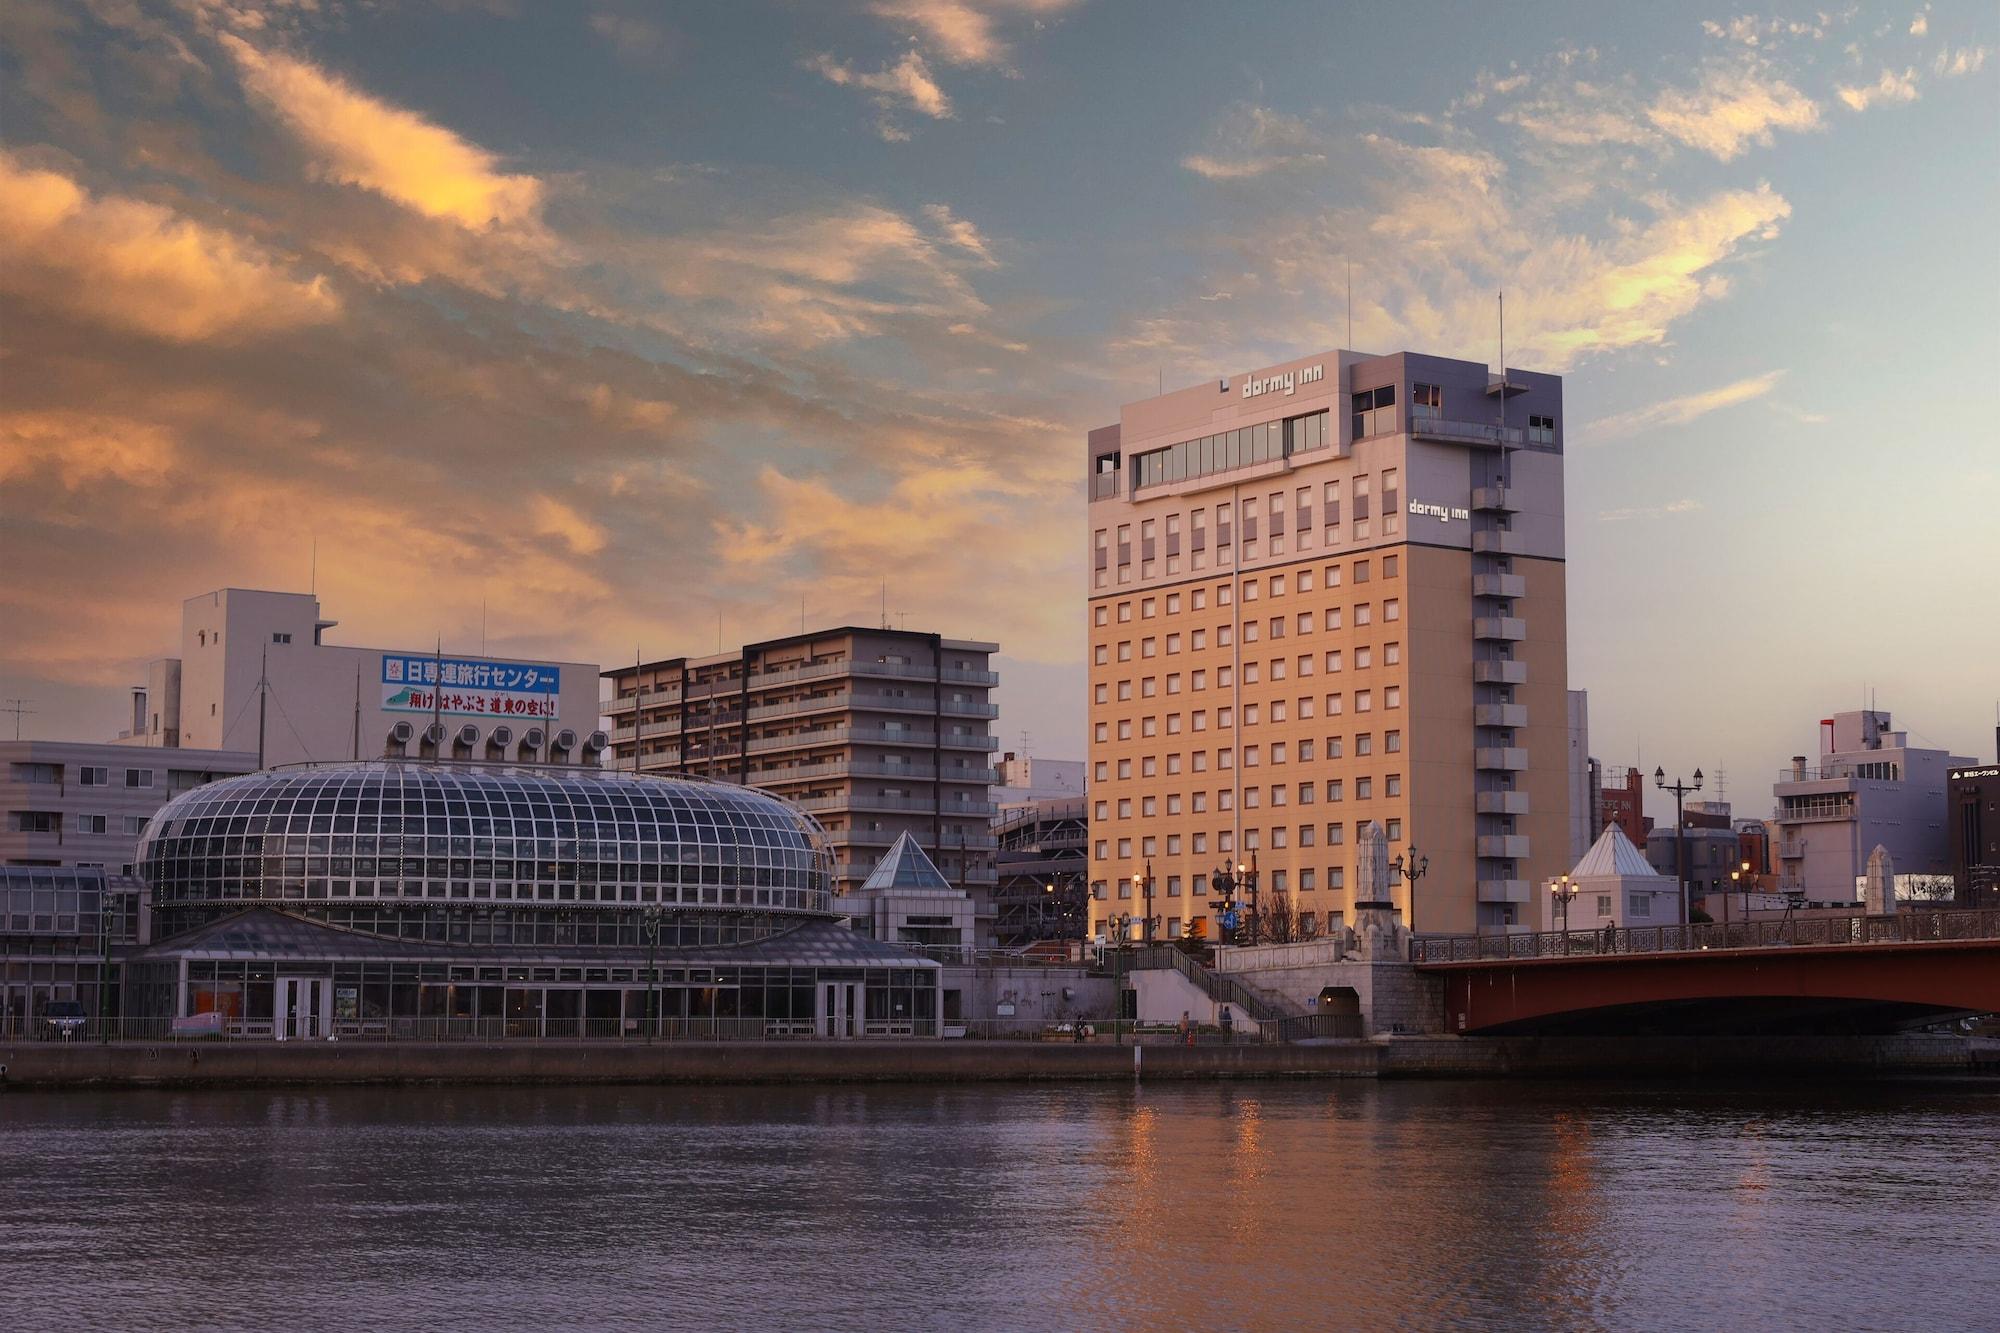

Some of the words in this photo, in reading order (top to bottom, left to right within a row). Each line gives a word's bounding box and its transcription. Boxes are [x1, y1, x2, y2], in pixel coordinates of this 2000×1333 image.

[1242, 373, 1295, 398] dormy
[1299, 364, 1323, 385] inn
[1409, 499, 1448, 522] dormy
[1452, 509, 1469, 520] inn
[408, 661, 554, 688] 日専連旅行センター
